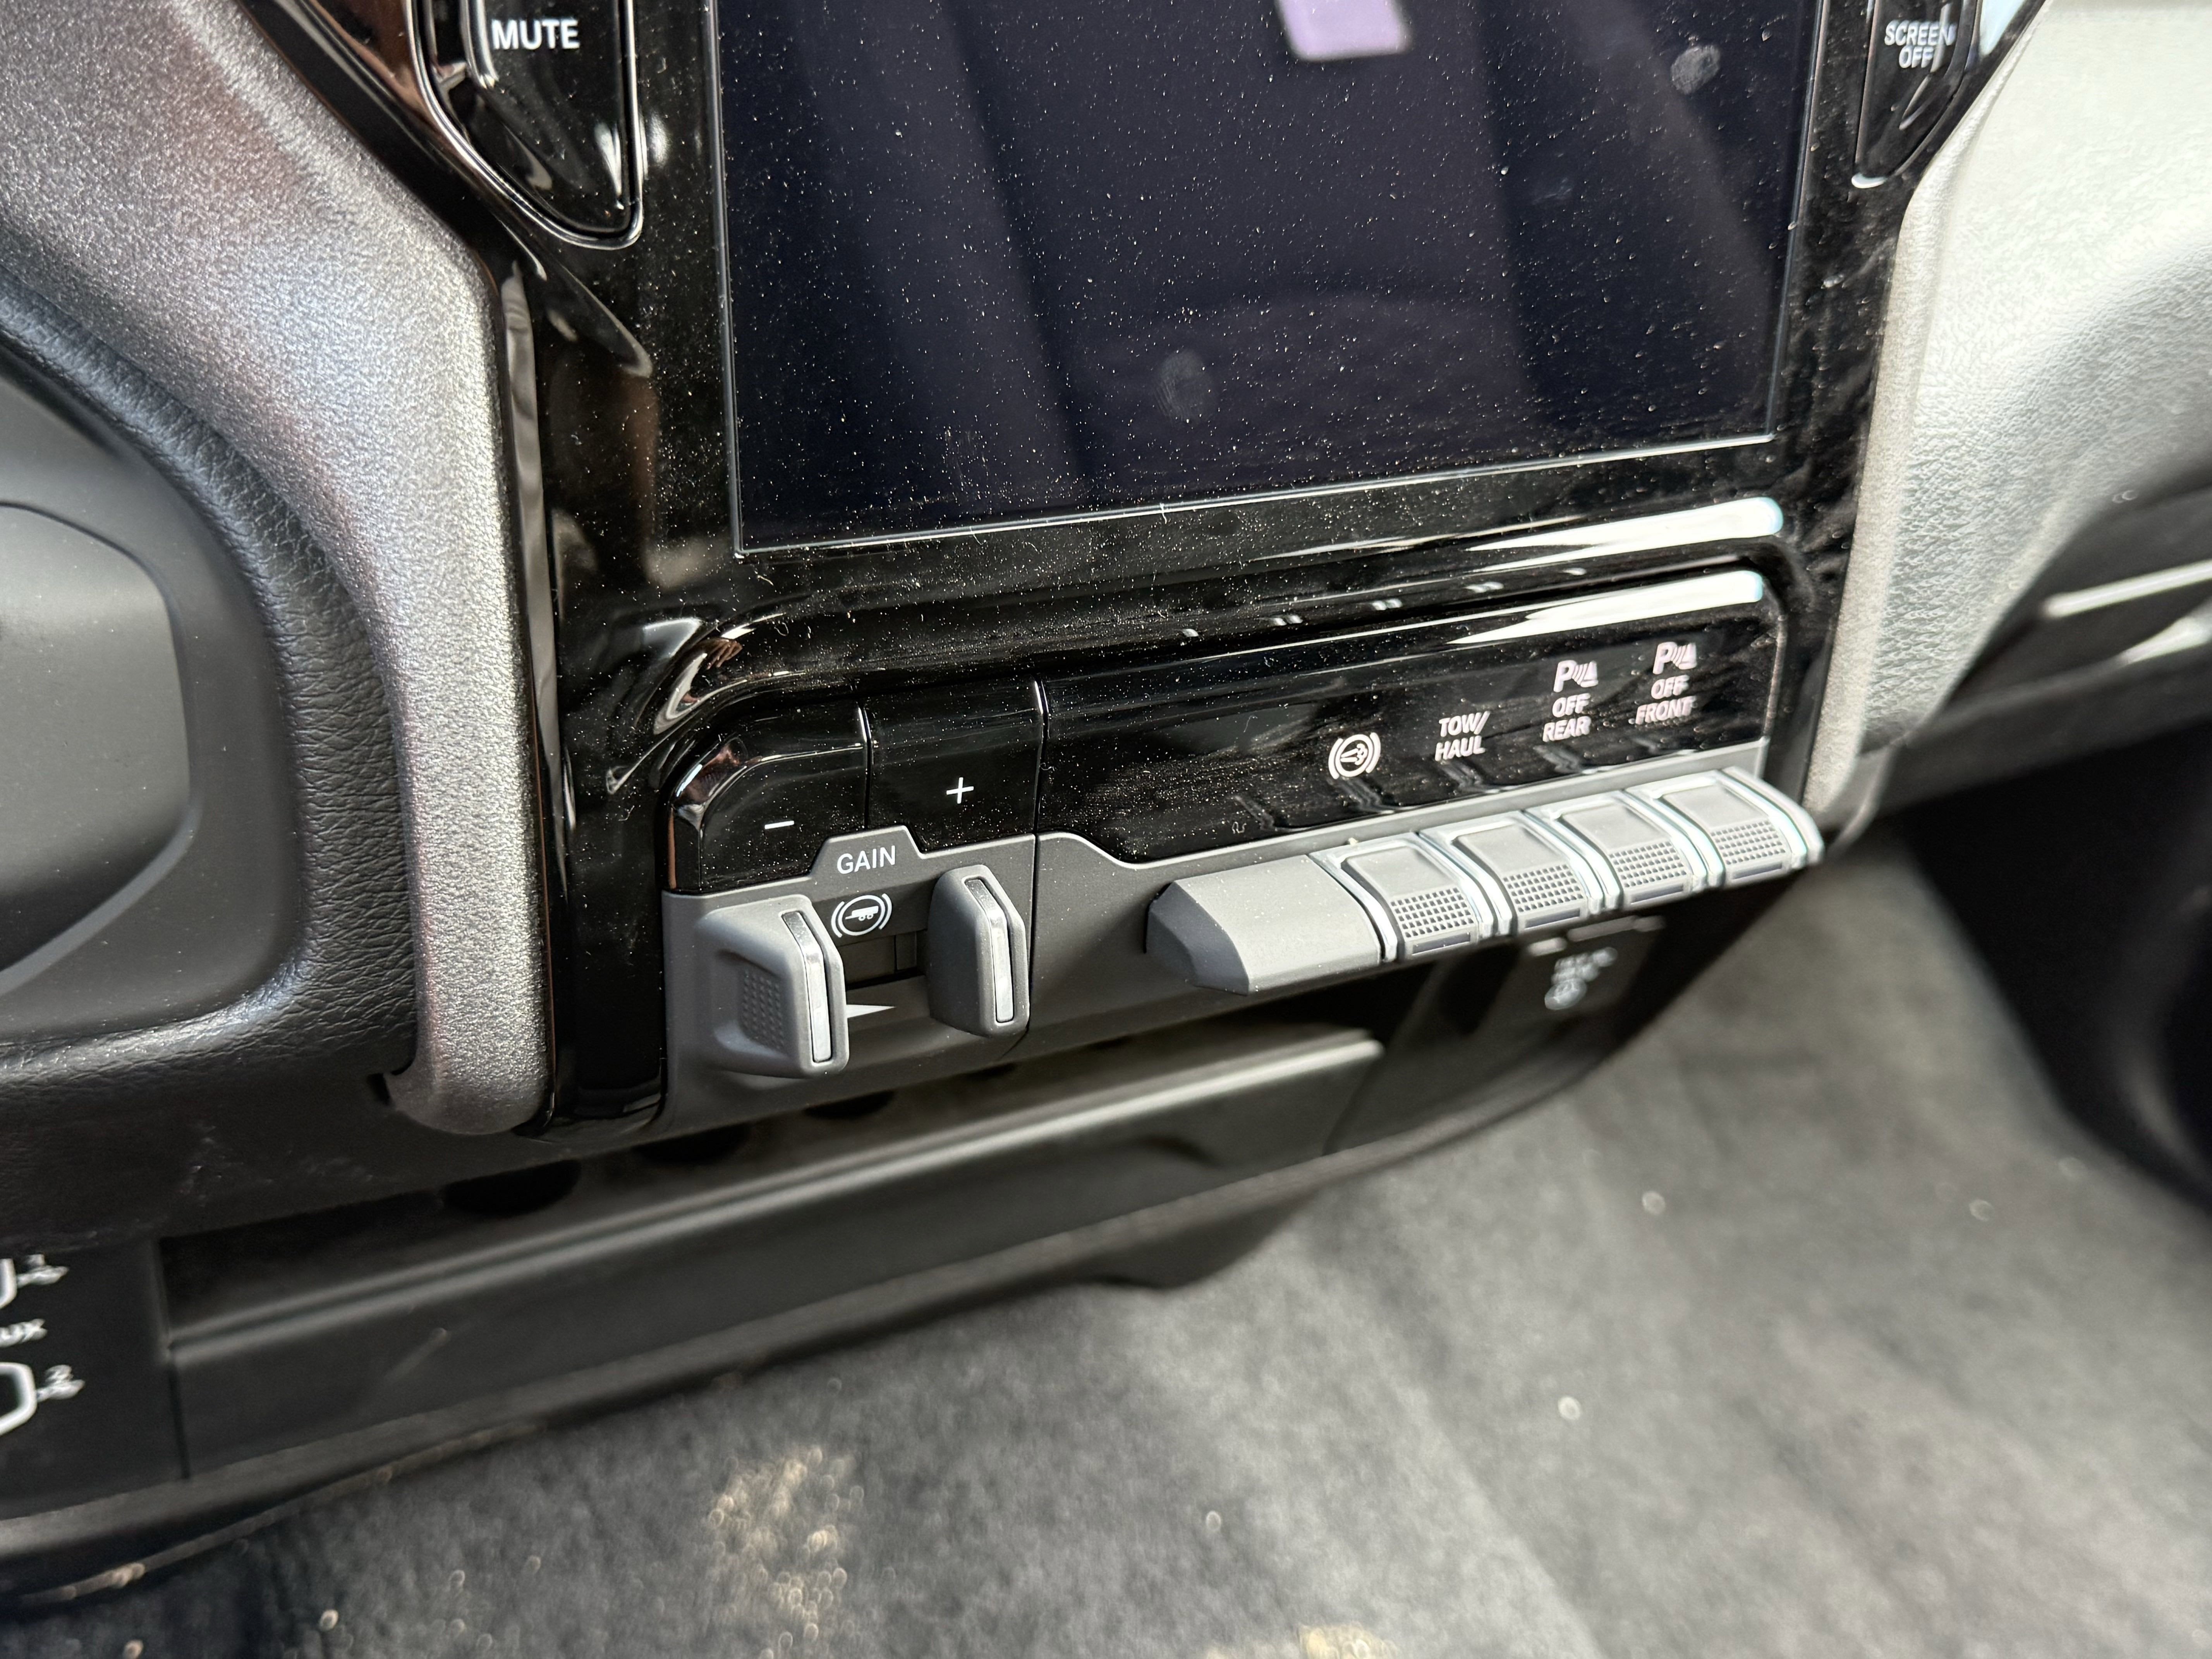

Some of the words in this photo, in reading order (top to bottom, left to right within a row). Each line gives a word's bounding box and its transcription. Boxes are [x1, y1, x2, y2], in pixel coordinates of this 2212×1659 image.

[491, 18, 580, 50] MUTE
[1884, 19, 1957, 46] SCREEN
[1899, 45, 1934, 69] OFF
[1651, 674, 1690, 699] OFF
[1552, 692, 1591, 718] OFF
[1635, 696, 1697, 725] FRONT
[1439, 711, 1491, 737] TOW/
[1542, 715, 1592, 742] REAR
[1435, 735, 1486, 761] HAUL
[836, 845, 896, 874] GAIN
